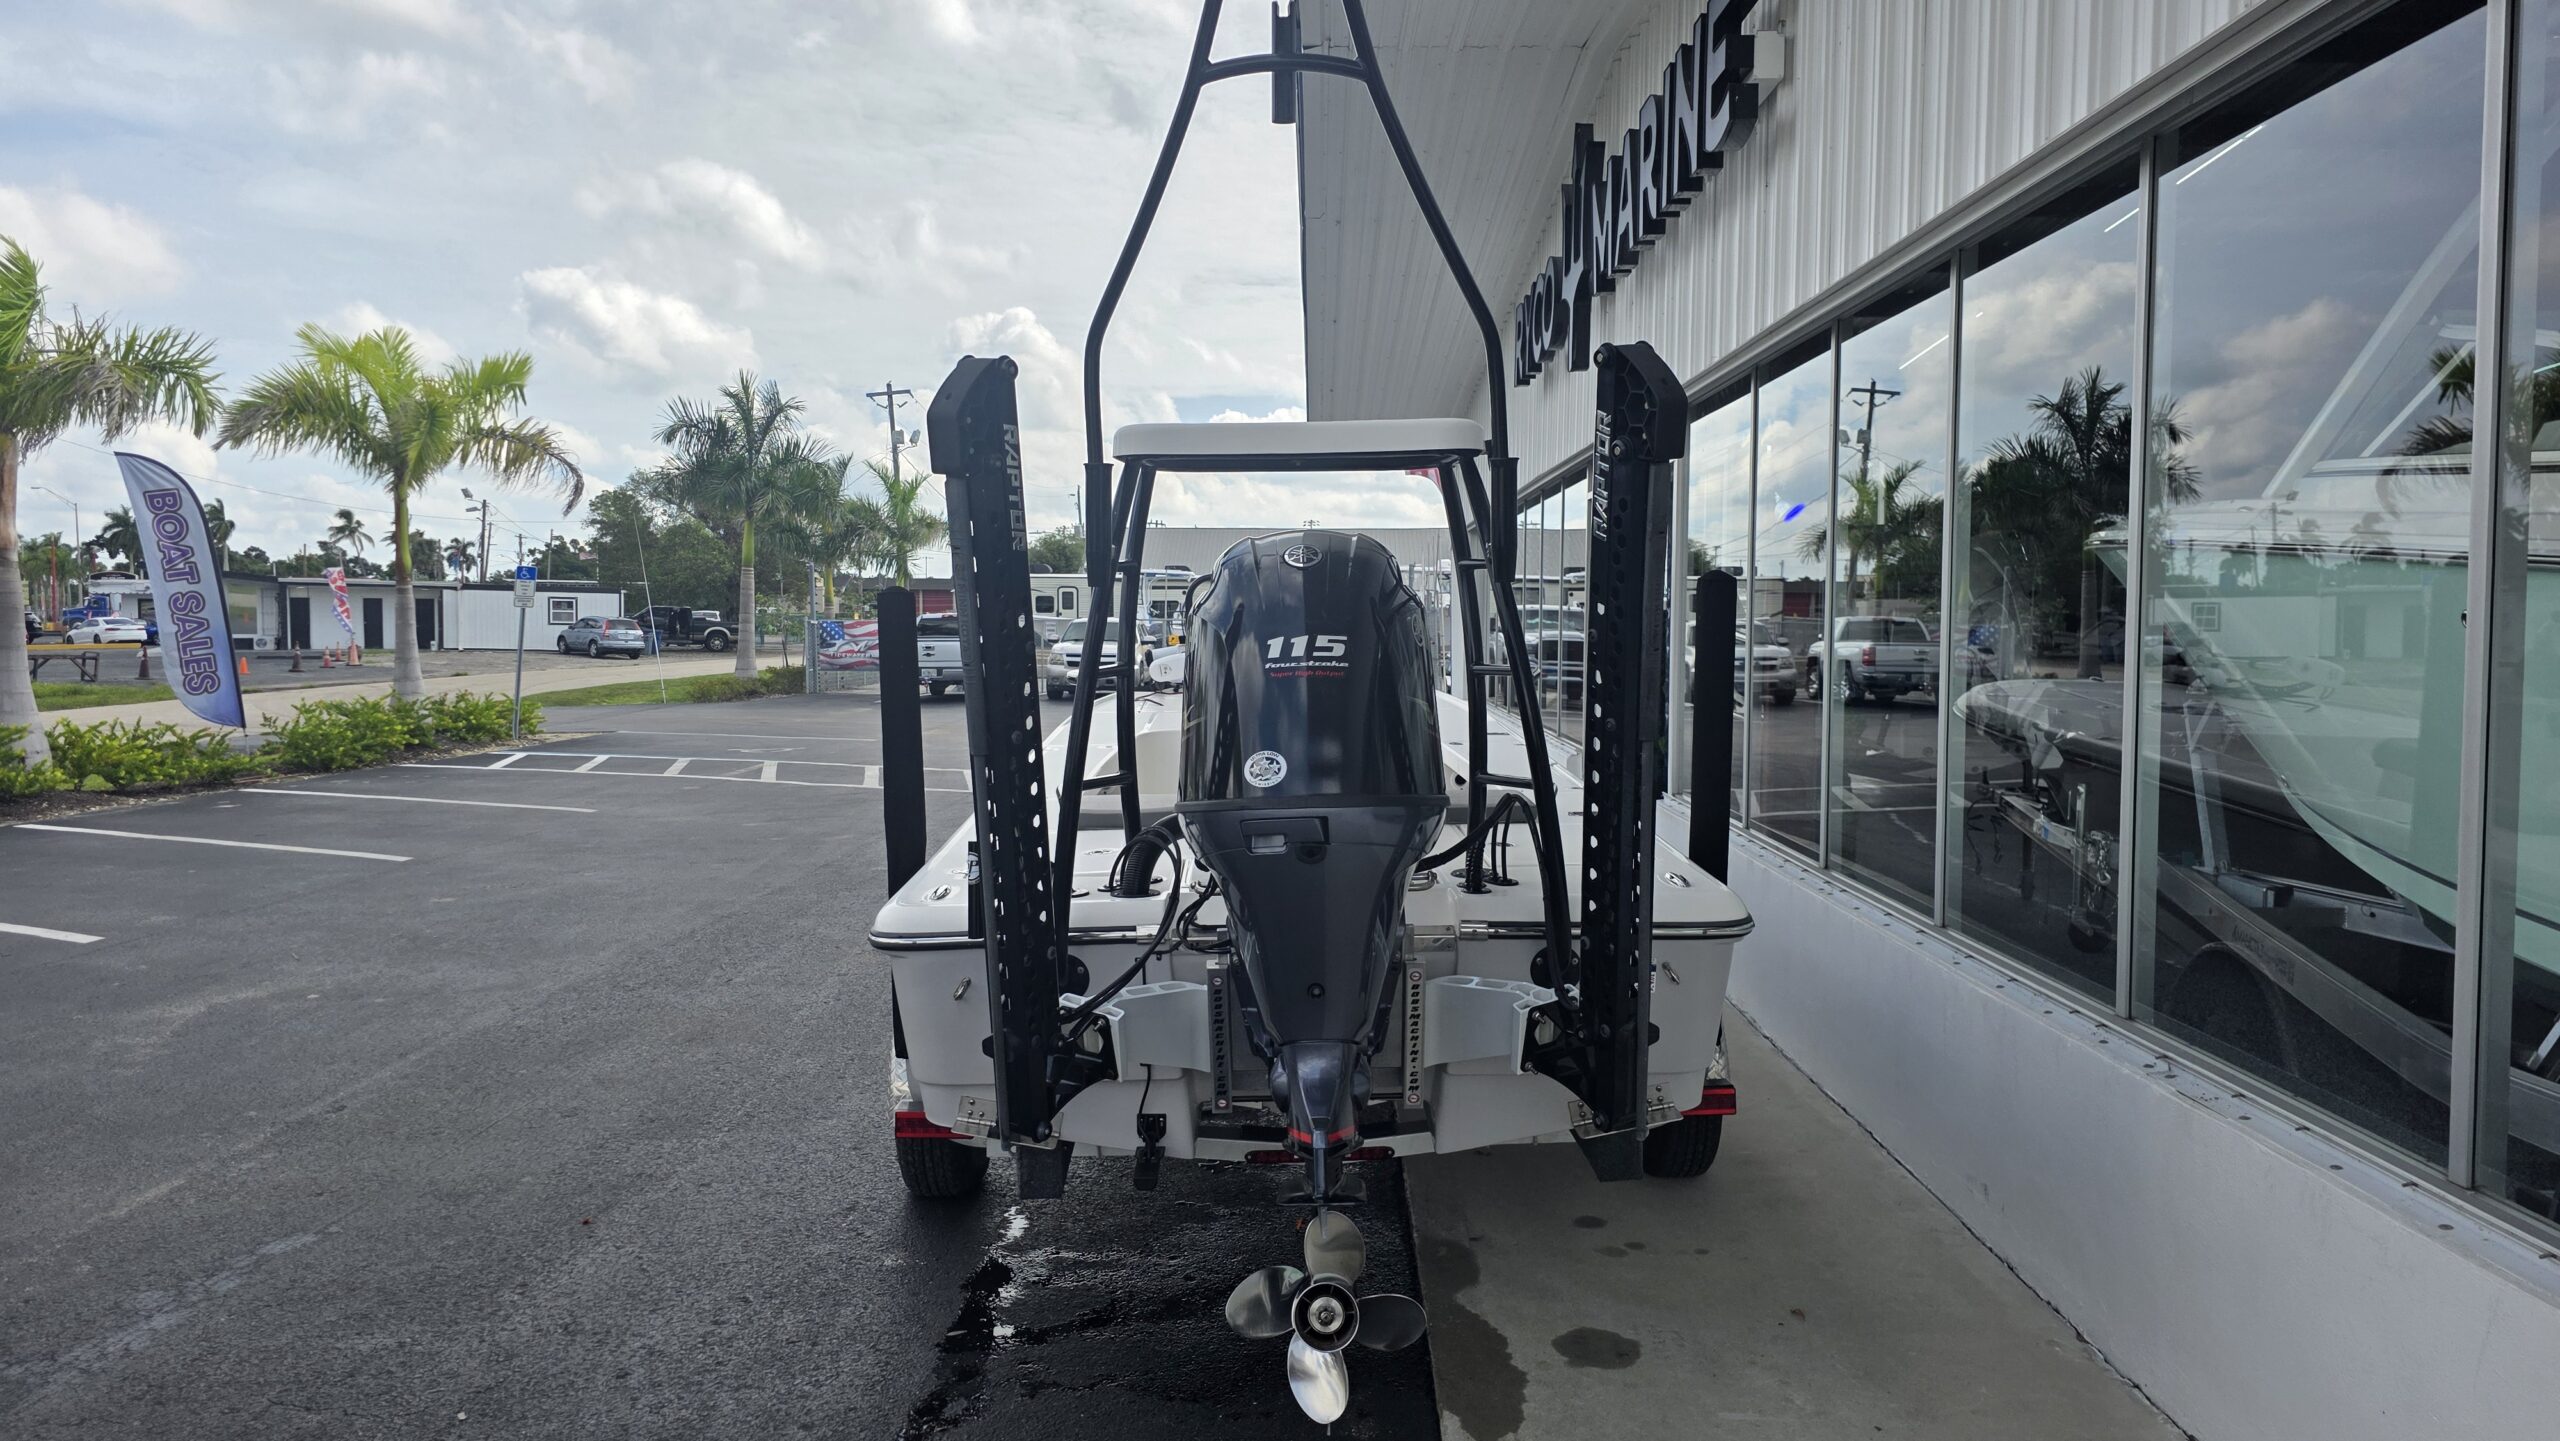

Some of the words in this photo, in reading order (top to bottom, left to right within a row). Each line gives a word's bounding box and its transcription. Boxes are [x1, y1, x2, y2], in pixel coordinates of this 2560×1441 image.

[1514, 256, 1566, 387] RYCO
[1592, 0, 1758, 297] MARINE
[143, 487, 201, 584] BOAT
[1003, 423, 1026, 551] RAPTOR
[169, 591, 220, 695] SALES
[1267, 634, 1348, 658] 115
